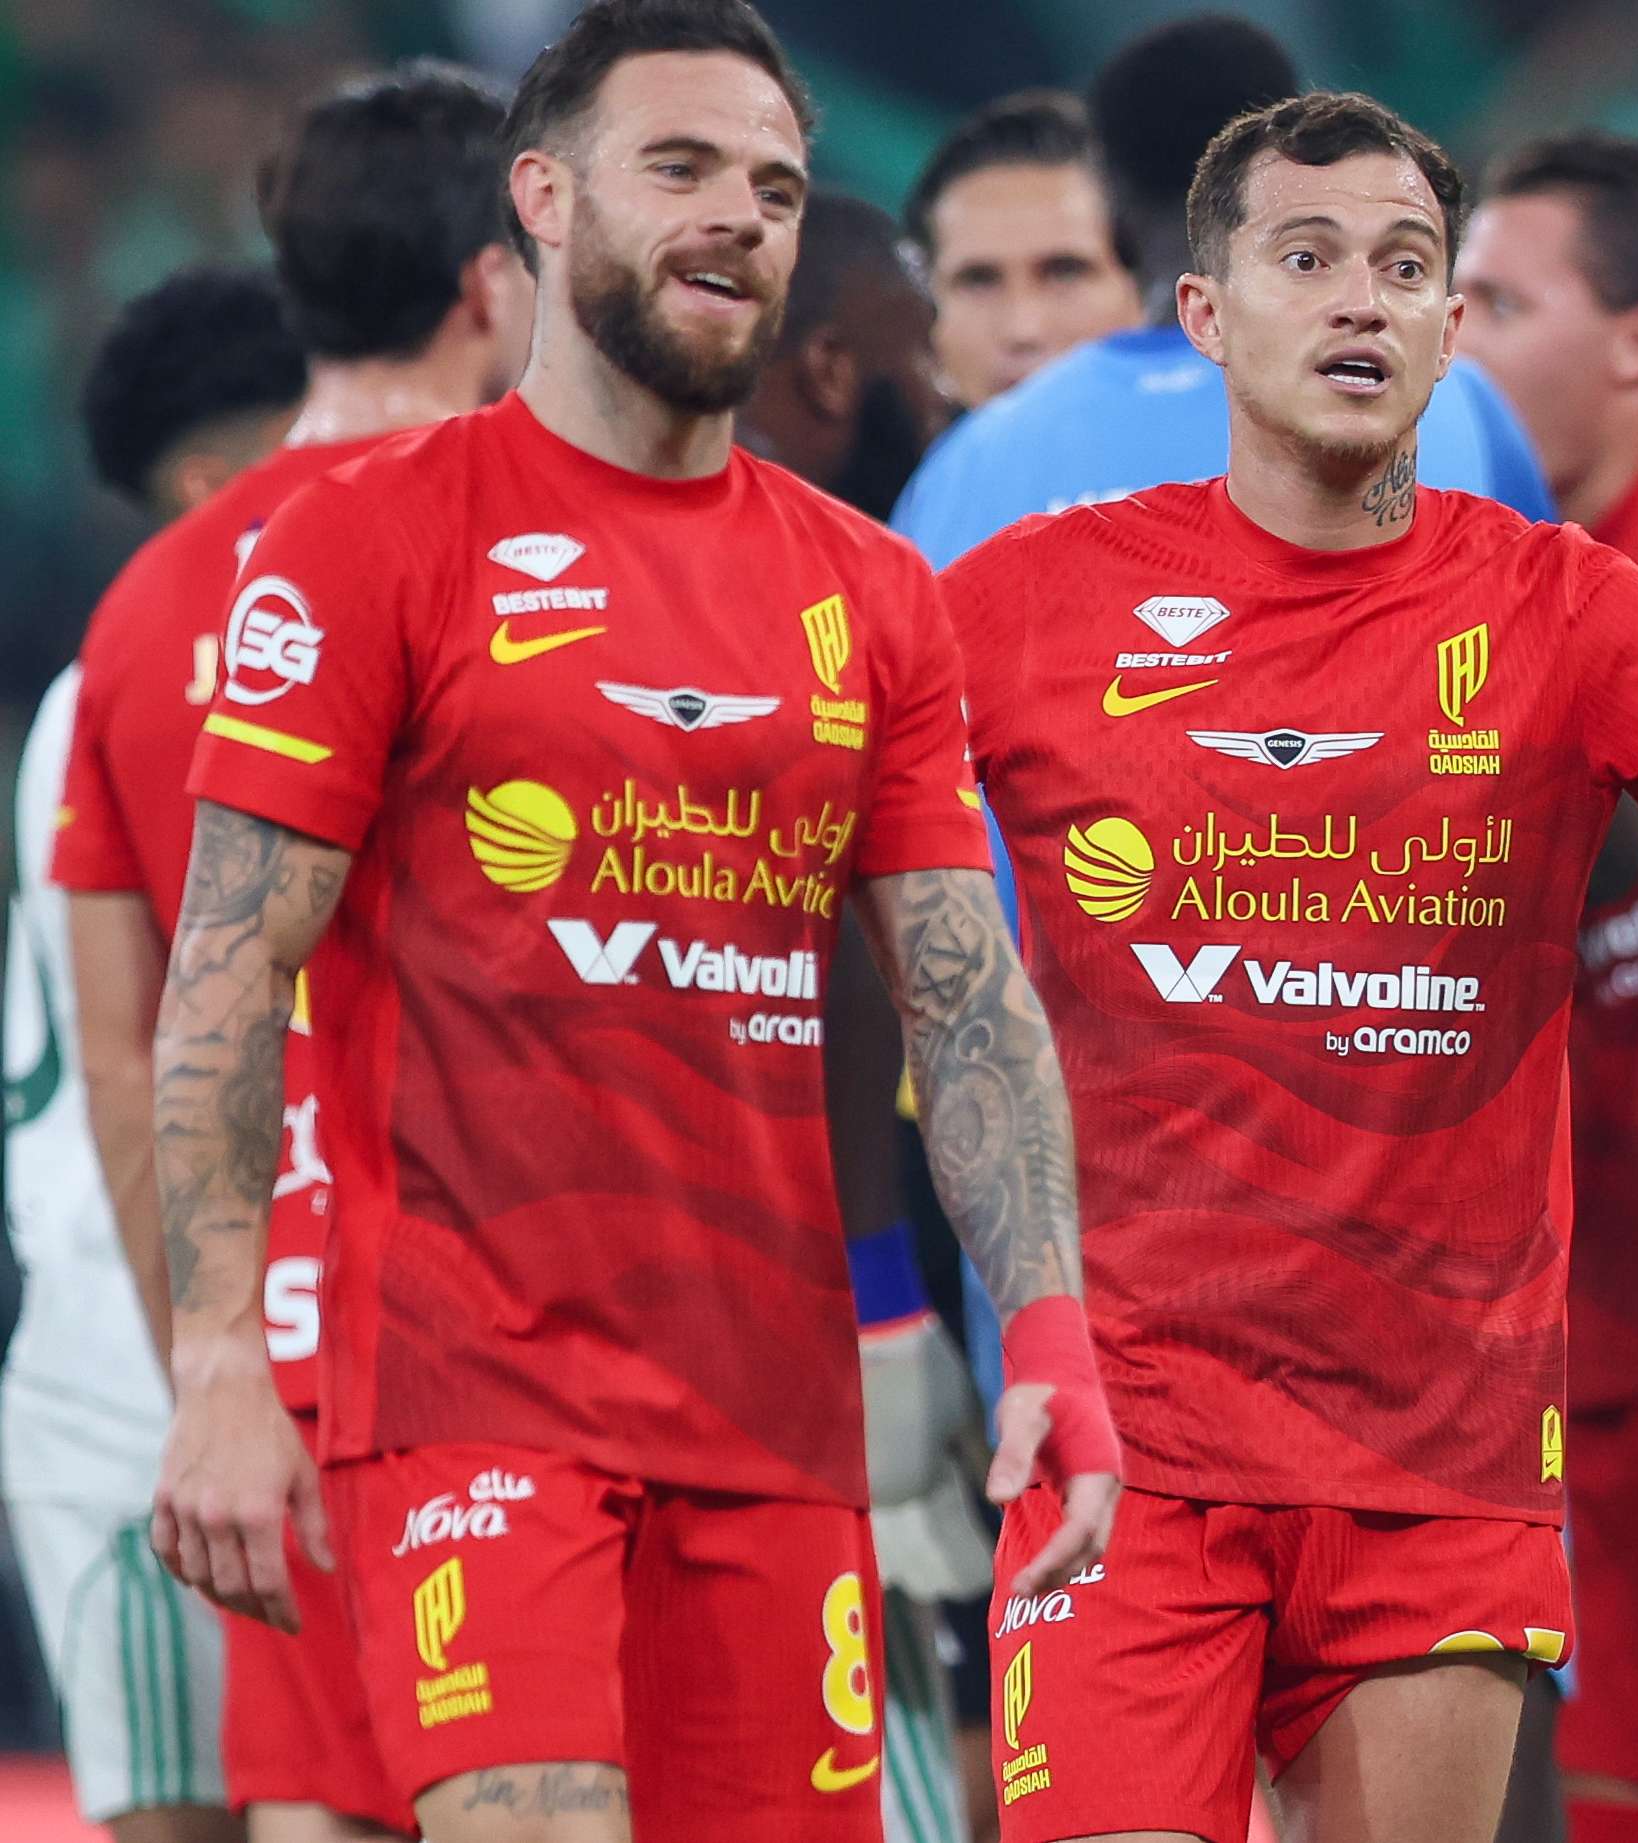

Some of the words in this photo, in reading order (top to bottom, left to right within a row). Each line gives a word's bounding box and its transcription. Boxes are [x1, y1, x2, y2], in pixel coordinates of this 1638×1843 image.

[491, 587, 609, 616] BESTEBIT
[1156, 606, 1206, 619] BESTE
[1115, 650, 1232, 669] BESTEBIT
[1267, 739, 1304, 749] GENESIS
[1428, 729, 1500, 752] القادسية
[1429, 754, 1500, 775] QADSIAH
[590, 777, 762, 843] للطيران
[1172, 811, 1358, 871] للطيران
[1371, 814, 1513, 878] الأولى
[591, 847, 736, 902] Aloula
[1171, 876, 1331, 923] Aloula
[1340, 879, 1506, 927] Aviation
[657, 938, 818, 1000] Valvoli
[1243, 960, 1480, 1012] Valvoline
[1326, 1031, 1350, 1056] by
[1353, 1026, 1471, 1056] aramco
[391, 1491, 511, 1558] Nova
[822, 1570, 875, 1735] 8
[1003, 1768, 1051, 1806] QADSIAH
